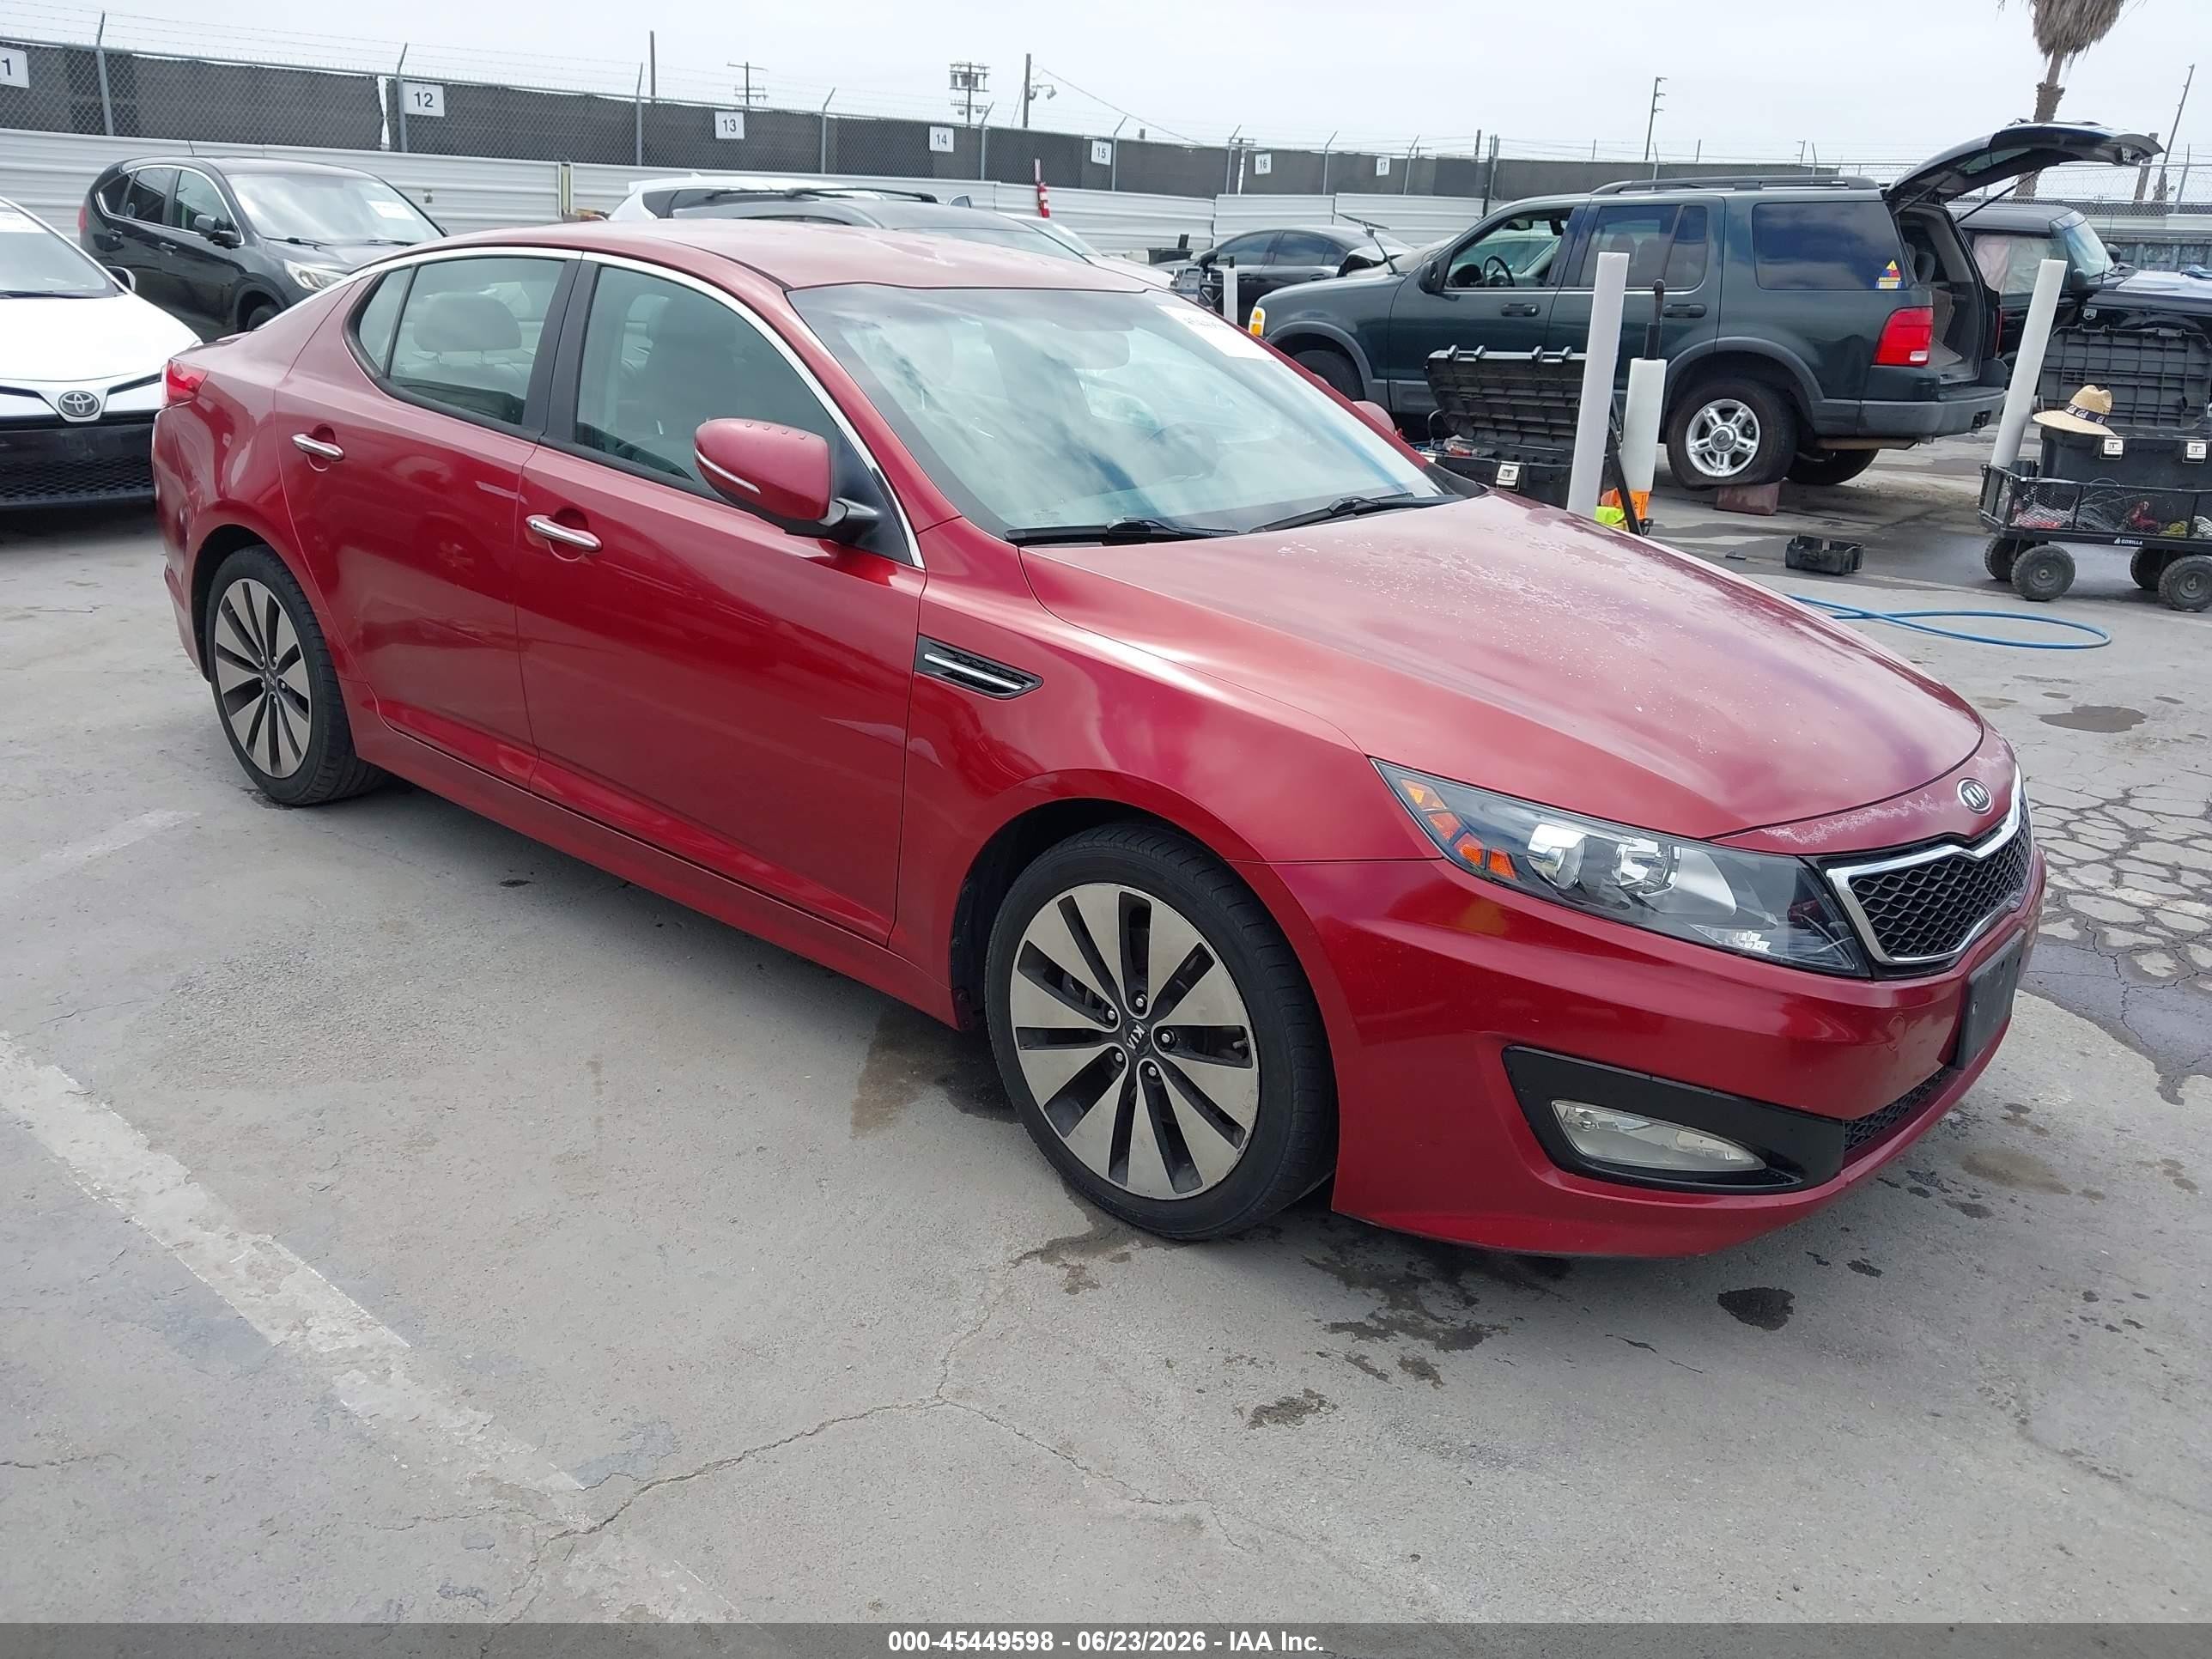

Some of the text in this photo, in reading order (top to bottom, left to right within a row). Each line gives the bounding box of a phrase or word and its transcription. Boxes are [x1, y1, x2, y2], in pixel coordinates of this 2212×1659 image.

[414, 91, 434, 107] 12
[722, 118, 737, 132] 13
[936, 133, 947, 145] 14
[1097, 147, 1106, 159] 15
[1260, 158, 1267, 169] 16
[1380, 161, 1387, 171] 17
[1963, 784, 1989, 807] KIA
[1126, 1024, 1146, 1049] KIA
